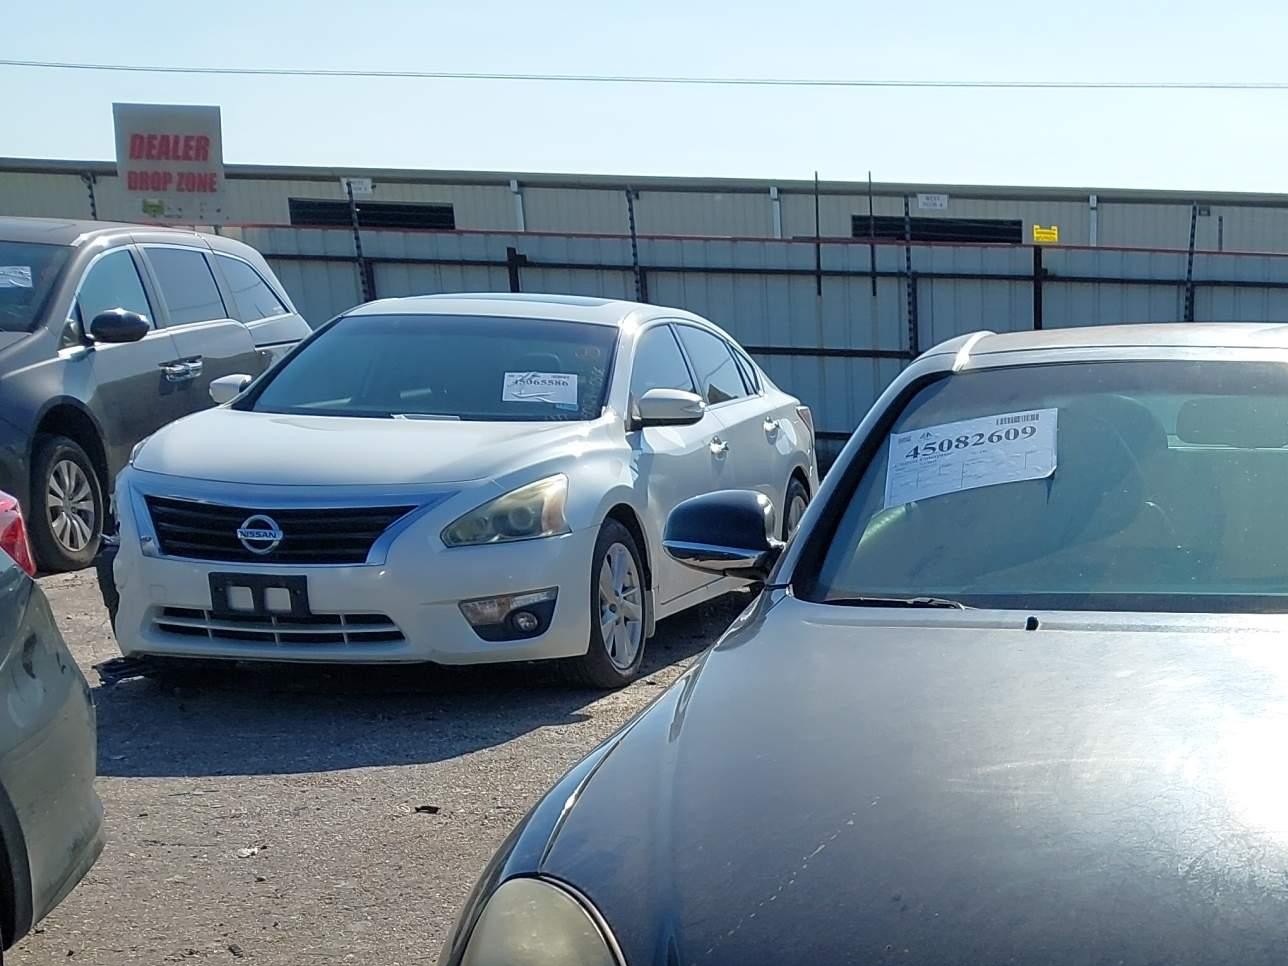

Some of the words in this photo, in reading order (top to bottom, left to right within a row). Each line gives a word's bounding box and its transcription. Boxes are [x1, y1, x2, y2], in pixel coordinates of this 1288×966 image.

[129, 133, 210, 161] DEALER
[127, 170, 172, 191] DROP
[175, 172, 217, 193] ZONE
[904, 425, 1037, 459] 45082609
[239, 530, 277, 538] NISSAN
